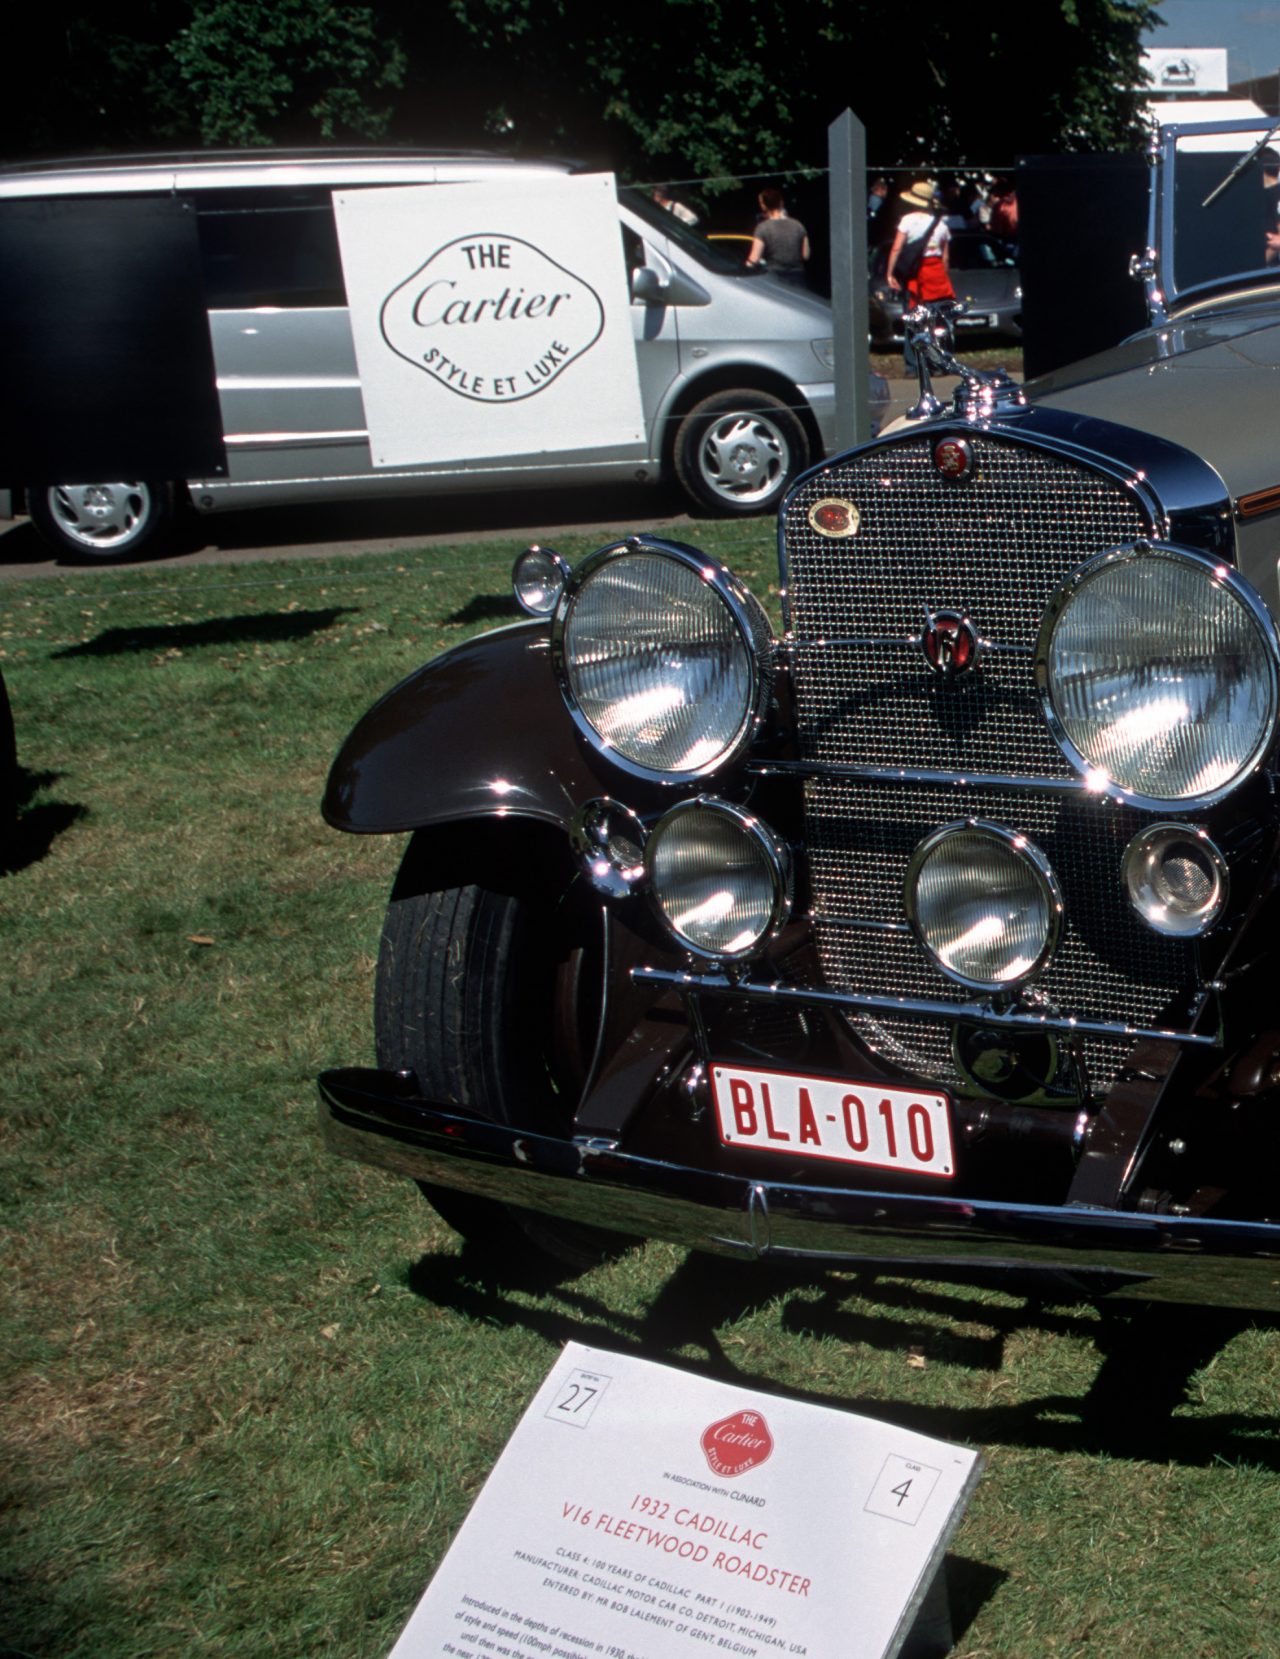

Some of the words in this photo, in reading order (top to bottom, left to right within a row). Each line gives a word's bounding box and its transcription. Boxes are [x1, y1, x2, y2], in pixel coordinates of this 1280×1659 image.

[461, 244, 511, 270] THE
[412, 279, 571, 328] Cartier
[423, 348, 483, 395] STYLE
[494, 377, 517, 396] ET
[525, 340, 570, 387] LUXE
[730, 1078, 935, 1162] BLA-010
[558, 1383, 597, 1413] 27
[742, 1413, 758, 1427] THE
[713, 1423, 766, 1449] Cartier
[708, 1447, 722, 1469] STYLE
[721, 1465, 732, 1474] ET
[730, 1491, 766, 1508] CUNARD
[890, 1478, 913, 1507] 4
[630, 1495, 670, 1520] 1932
[674, 1508, 768, 1550] CADILLAC
[562, 1501, 592, 1526] V16
[595, 1513, 708, 1562] FLEETWOOD
[712, 1551, 812, 1597] ROADSTER
[556, 1547, 580, 1562] CLASS
[592, 1558, 606, 1571] 100
[607, 1563, 633, 1579] YEARS
[634, 1573, 647, 1583] OF
[648, 1577, 691, 1599] CADILLAC
[695, 1593, 718, 1608] PART
[454, 1610, 464, 1620] of
[463, 1615, 481, 1628] style
[482, 1621, 496, 1633] and
[496, 1627, 519, 1641] speed
[461, 1594, 500, 1616] Introduced
[502, 1608, 509, 1618] in
[510, 1611, 523, 1624] the
[523, 1617, 549, 1634] depths
[550, 1627, 560, 1637] of
[559, 1630, 594, 1650] recession
[542, 1577, 580, 1597] ENTERED
[596, 1596, 609, 1607] MR
[610, 1601, 629, 1614] BOB
[630, 1608, 673, 1629] LALEMENT
[675, 1623, 688, 1634] OF
[717, 1637, 757, 1658] BELGIUM
[582, 1573, 624, 1594] CADILLAC
[625, 1588, 656, 1605] MOTOR
[658, 1599, 676, 1612] CAR
[789, 1643, 807, 1656] USA
[442, 1643, 456, 1654] the
[461, 1632, 478, 1643] until
[479, 1637, 495, 1649] then
[497, 1645, 511, 1656] was
